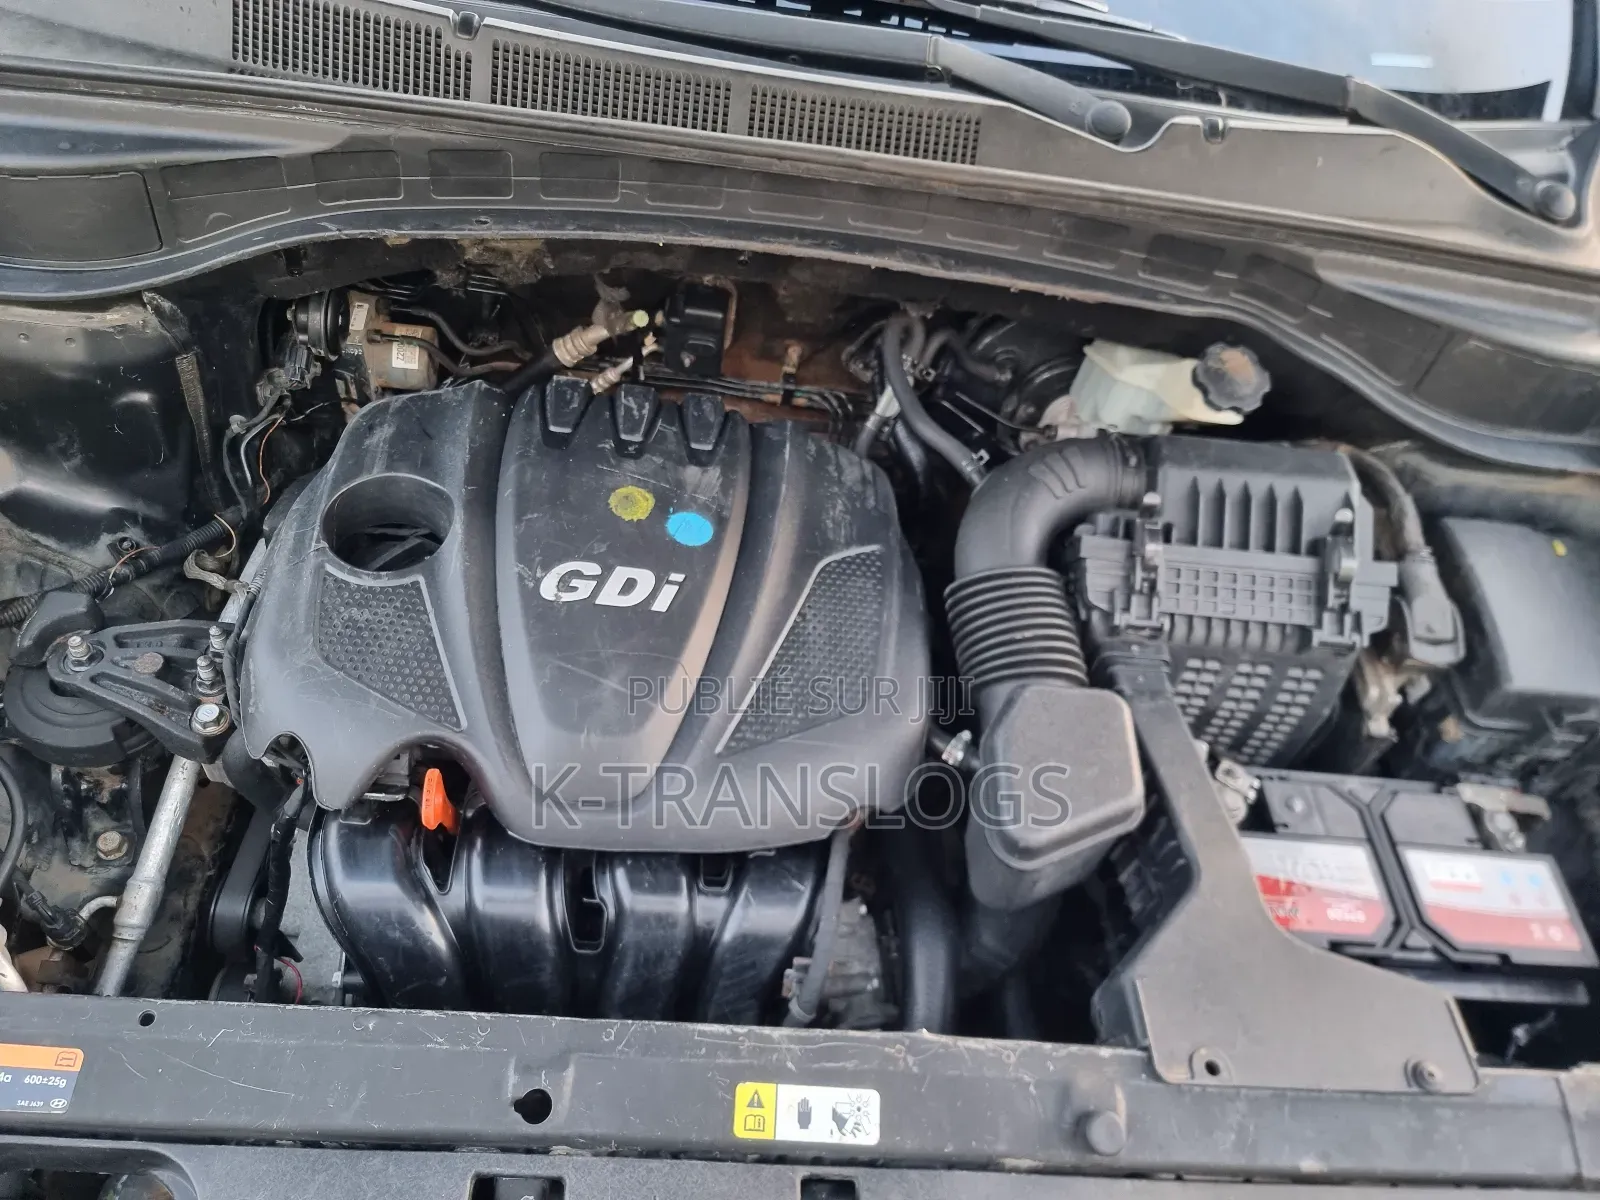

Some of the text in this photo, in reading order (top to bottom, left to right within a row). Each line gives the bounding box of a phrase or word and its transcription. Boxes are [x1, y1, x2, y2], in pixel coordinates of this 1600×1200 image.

[539, 560, 686, 613] GDi
[24, 1074, 67, 1088] 600±25g
[17, 1099, 29, 1107] SAE
